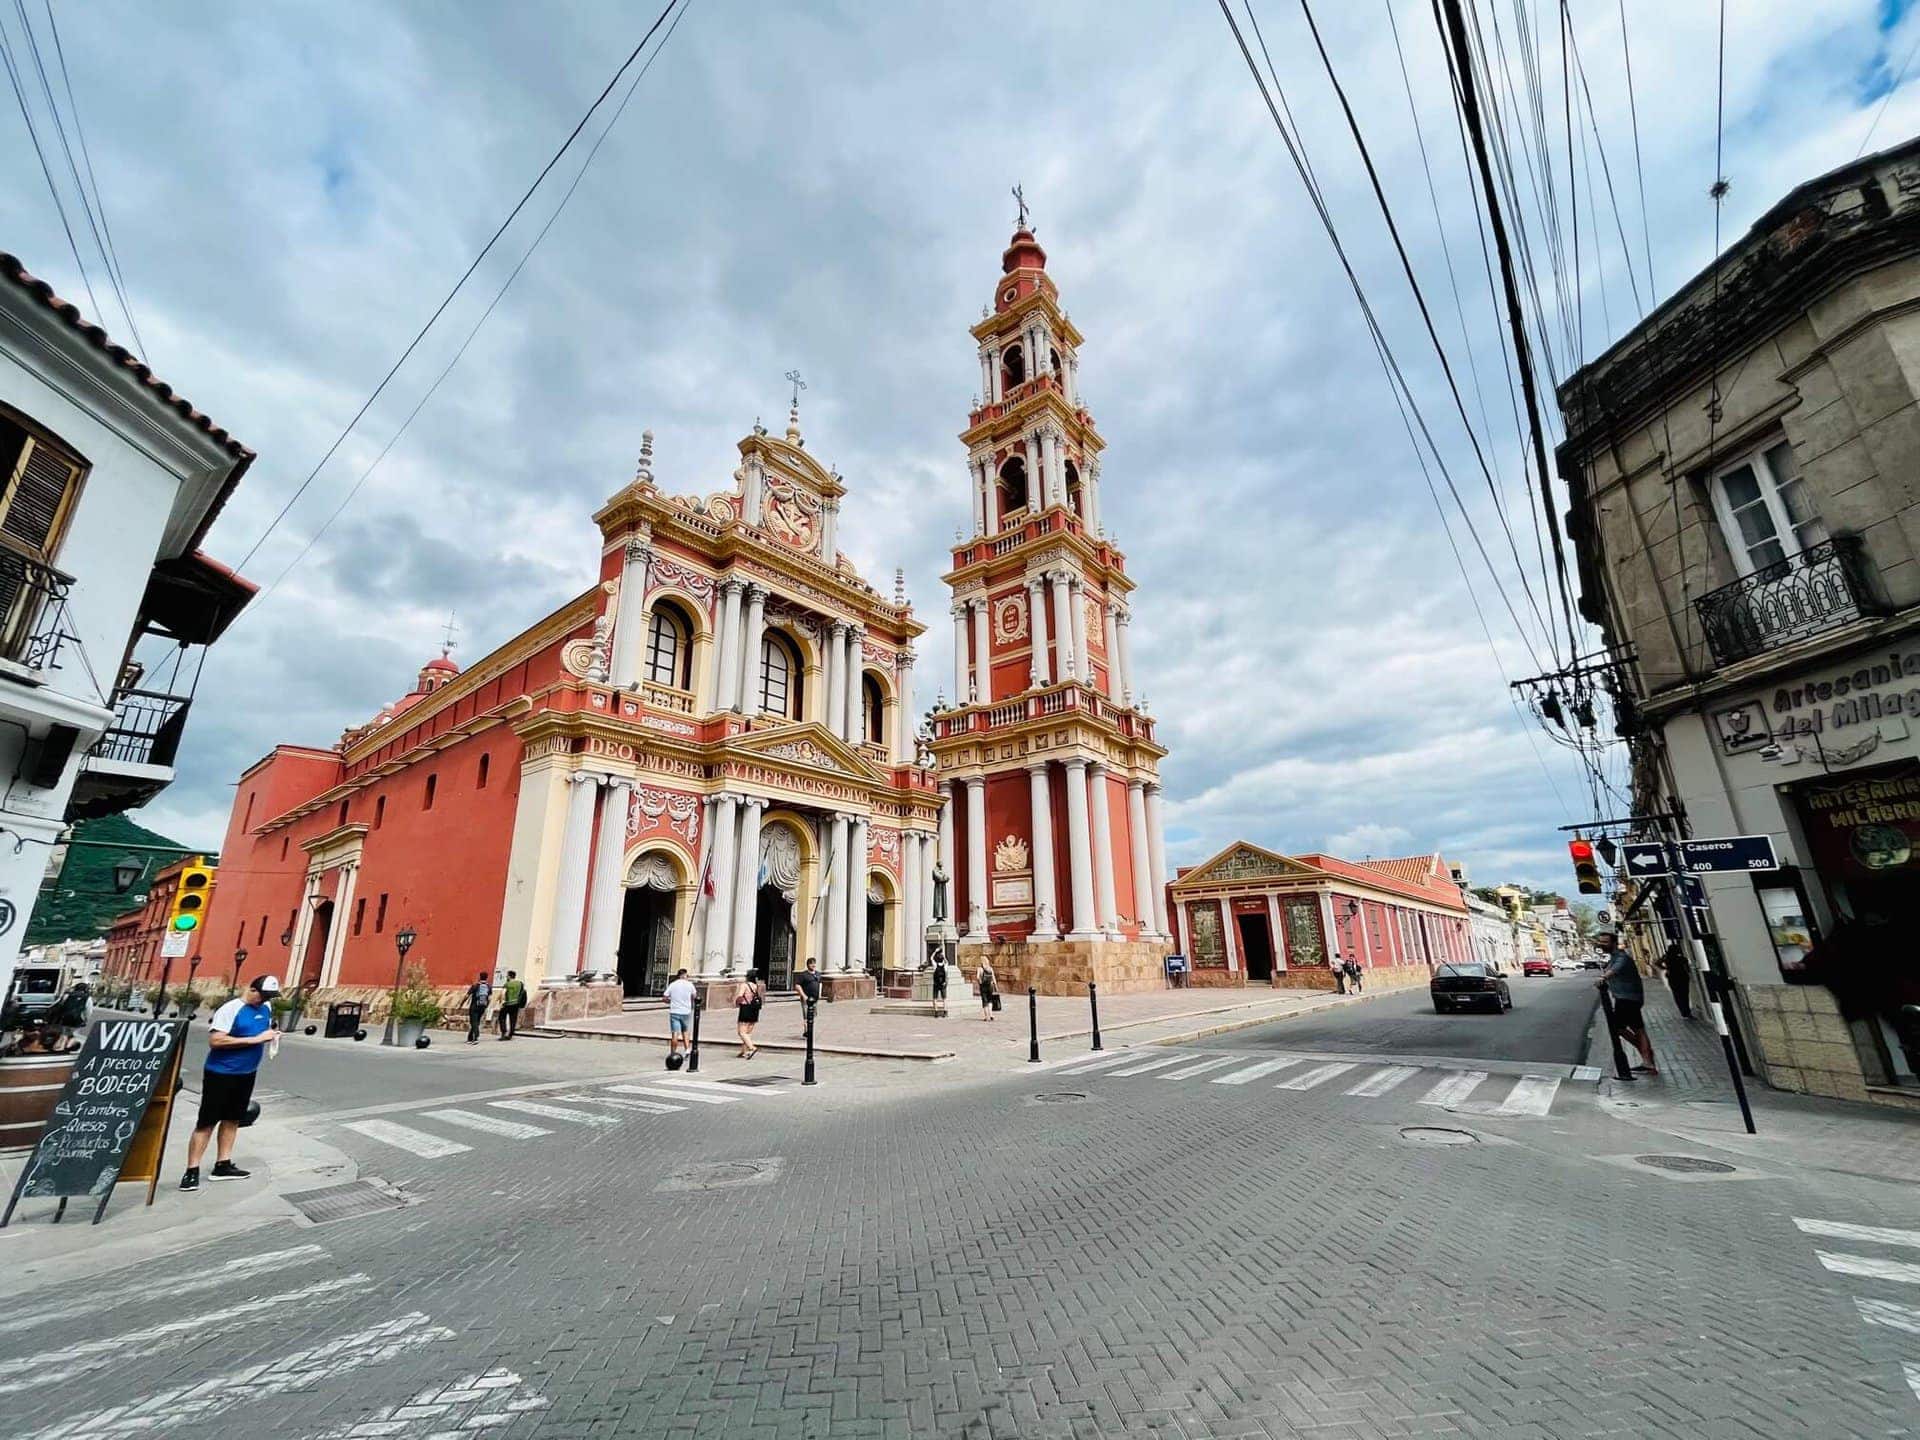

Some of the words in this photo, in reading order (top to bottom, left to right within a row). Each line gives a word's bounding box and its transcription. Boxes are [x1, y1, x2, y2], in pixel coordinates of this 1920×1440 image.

[1778, 709, 1823, 741] del
[591, 736, 632, 760] DEO
[1830, 801, 1920, 828] MILAGRO
[1687, 842, 1734, 851] Caseros
[1692, 862, 1713, 871] 400
[1748, 859, 1769, 868] 500
[100, 1021, 175, 1053] VINOS
[84, 1056, 97, 1070] A
[98, 1057, 142, 1076] precio
[145, 1055, 161, 1070] de
[78, 1073, 151, 1095] BODEGA
